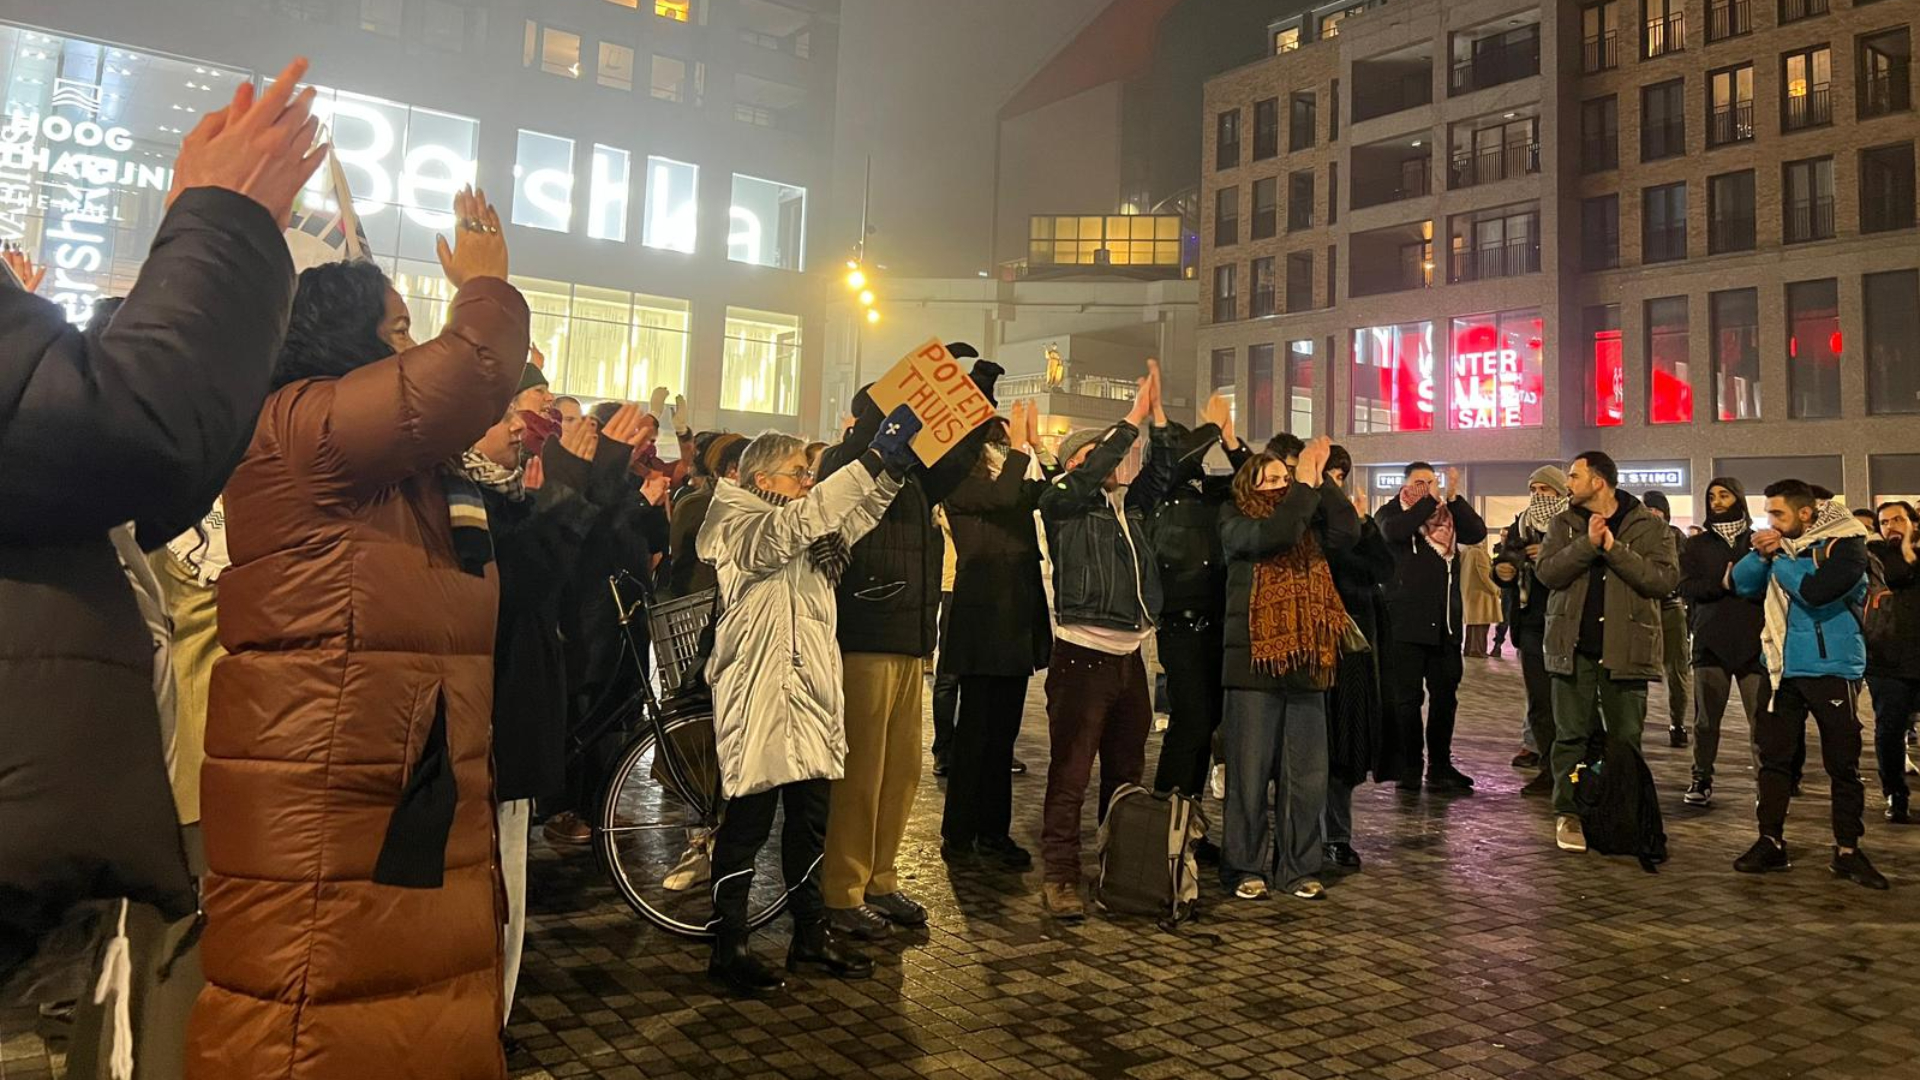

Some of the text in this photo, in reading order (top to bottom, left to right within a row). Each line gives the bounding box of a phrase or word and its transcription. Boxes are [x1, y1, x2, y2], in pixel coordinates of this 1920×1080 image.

[13, 109, 133, 152] HOOG
[898, 364, 964, 444] THUIS
[917, 343, 995, 427] POTEN
[1629, 473, 1677, 485] STING
